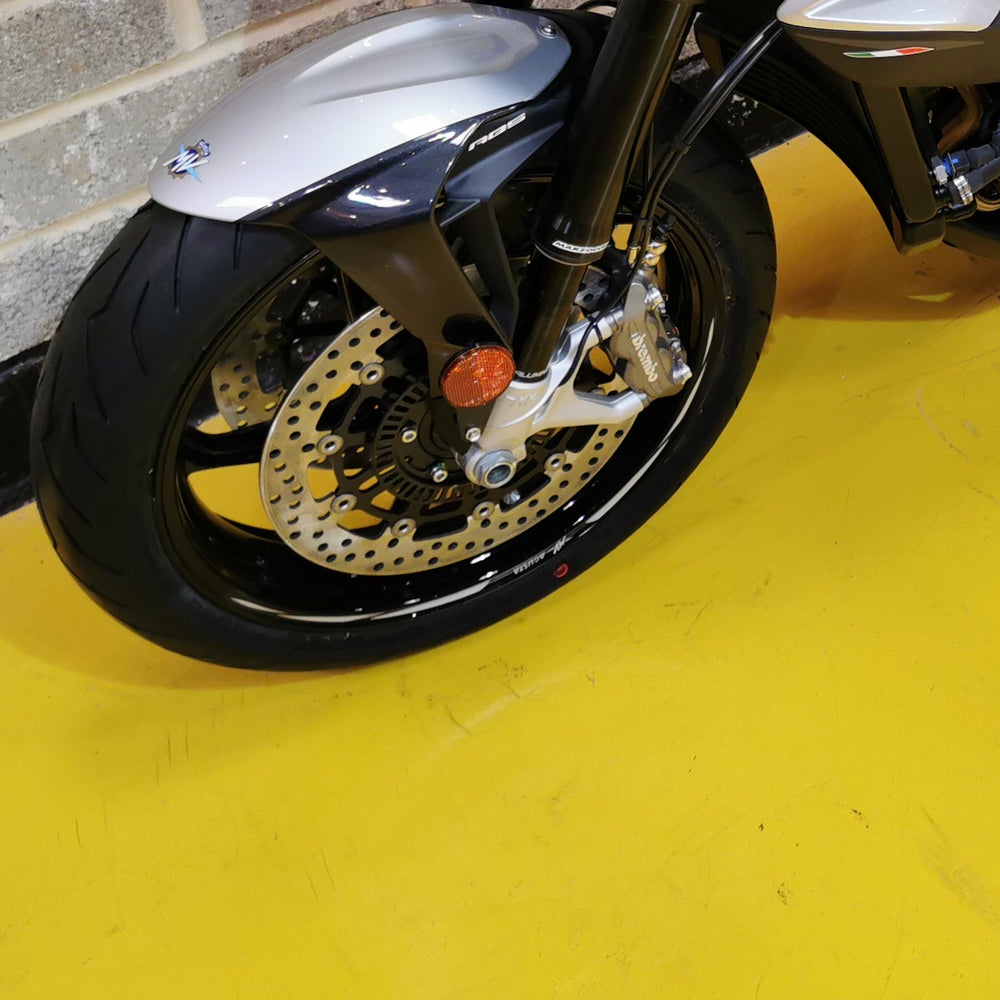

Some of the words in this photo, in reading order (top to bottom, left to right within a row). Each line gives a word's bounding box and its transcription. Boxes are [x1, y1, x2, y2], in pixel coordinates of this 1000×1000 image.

[468, 112, 526, 151] ABS
[631, 332, 658, 383] brembo
[513, 552, 546, 575] AGUSTA
